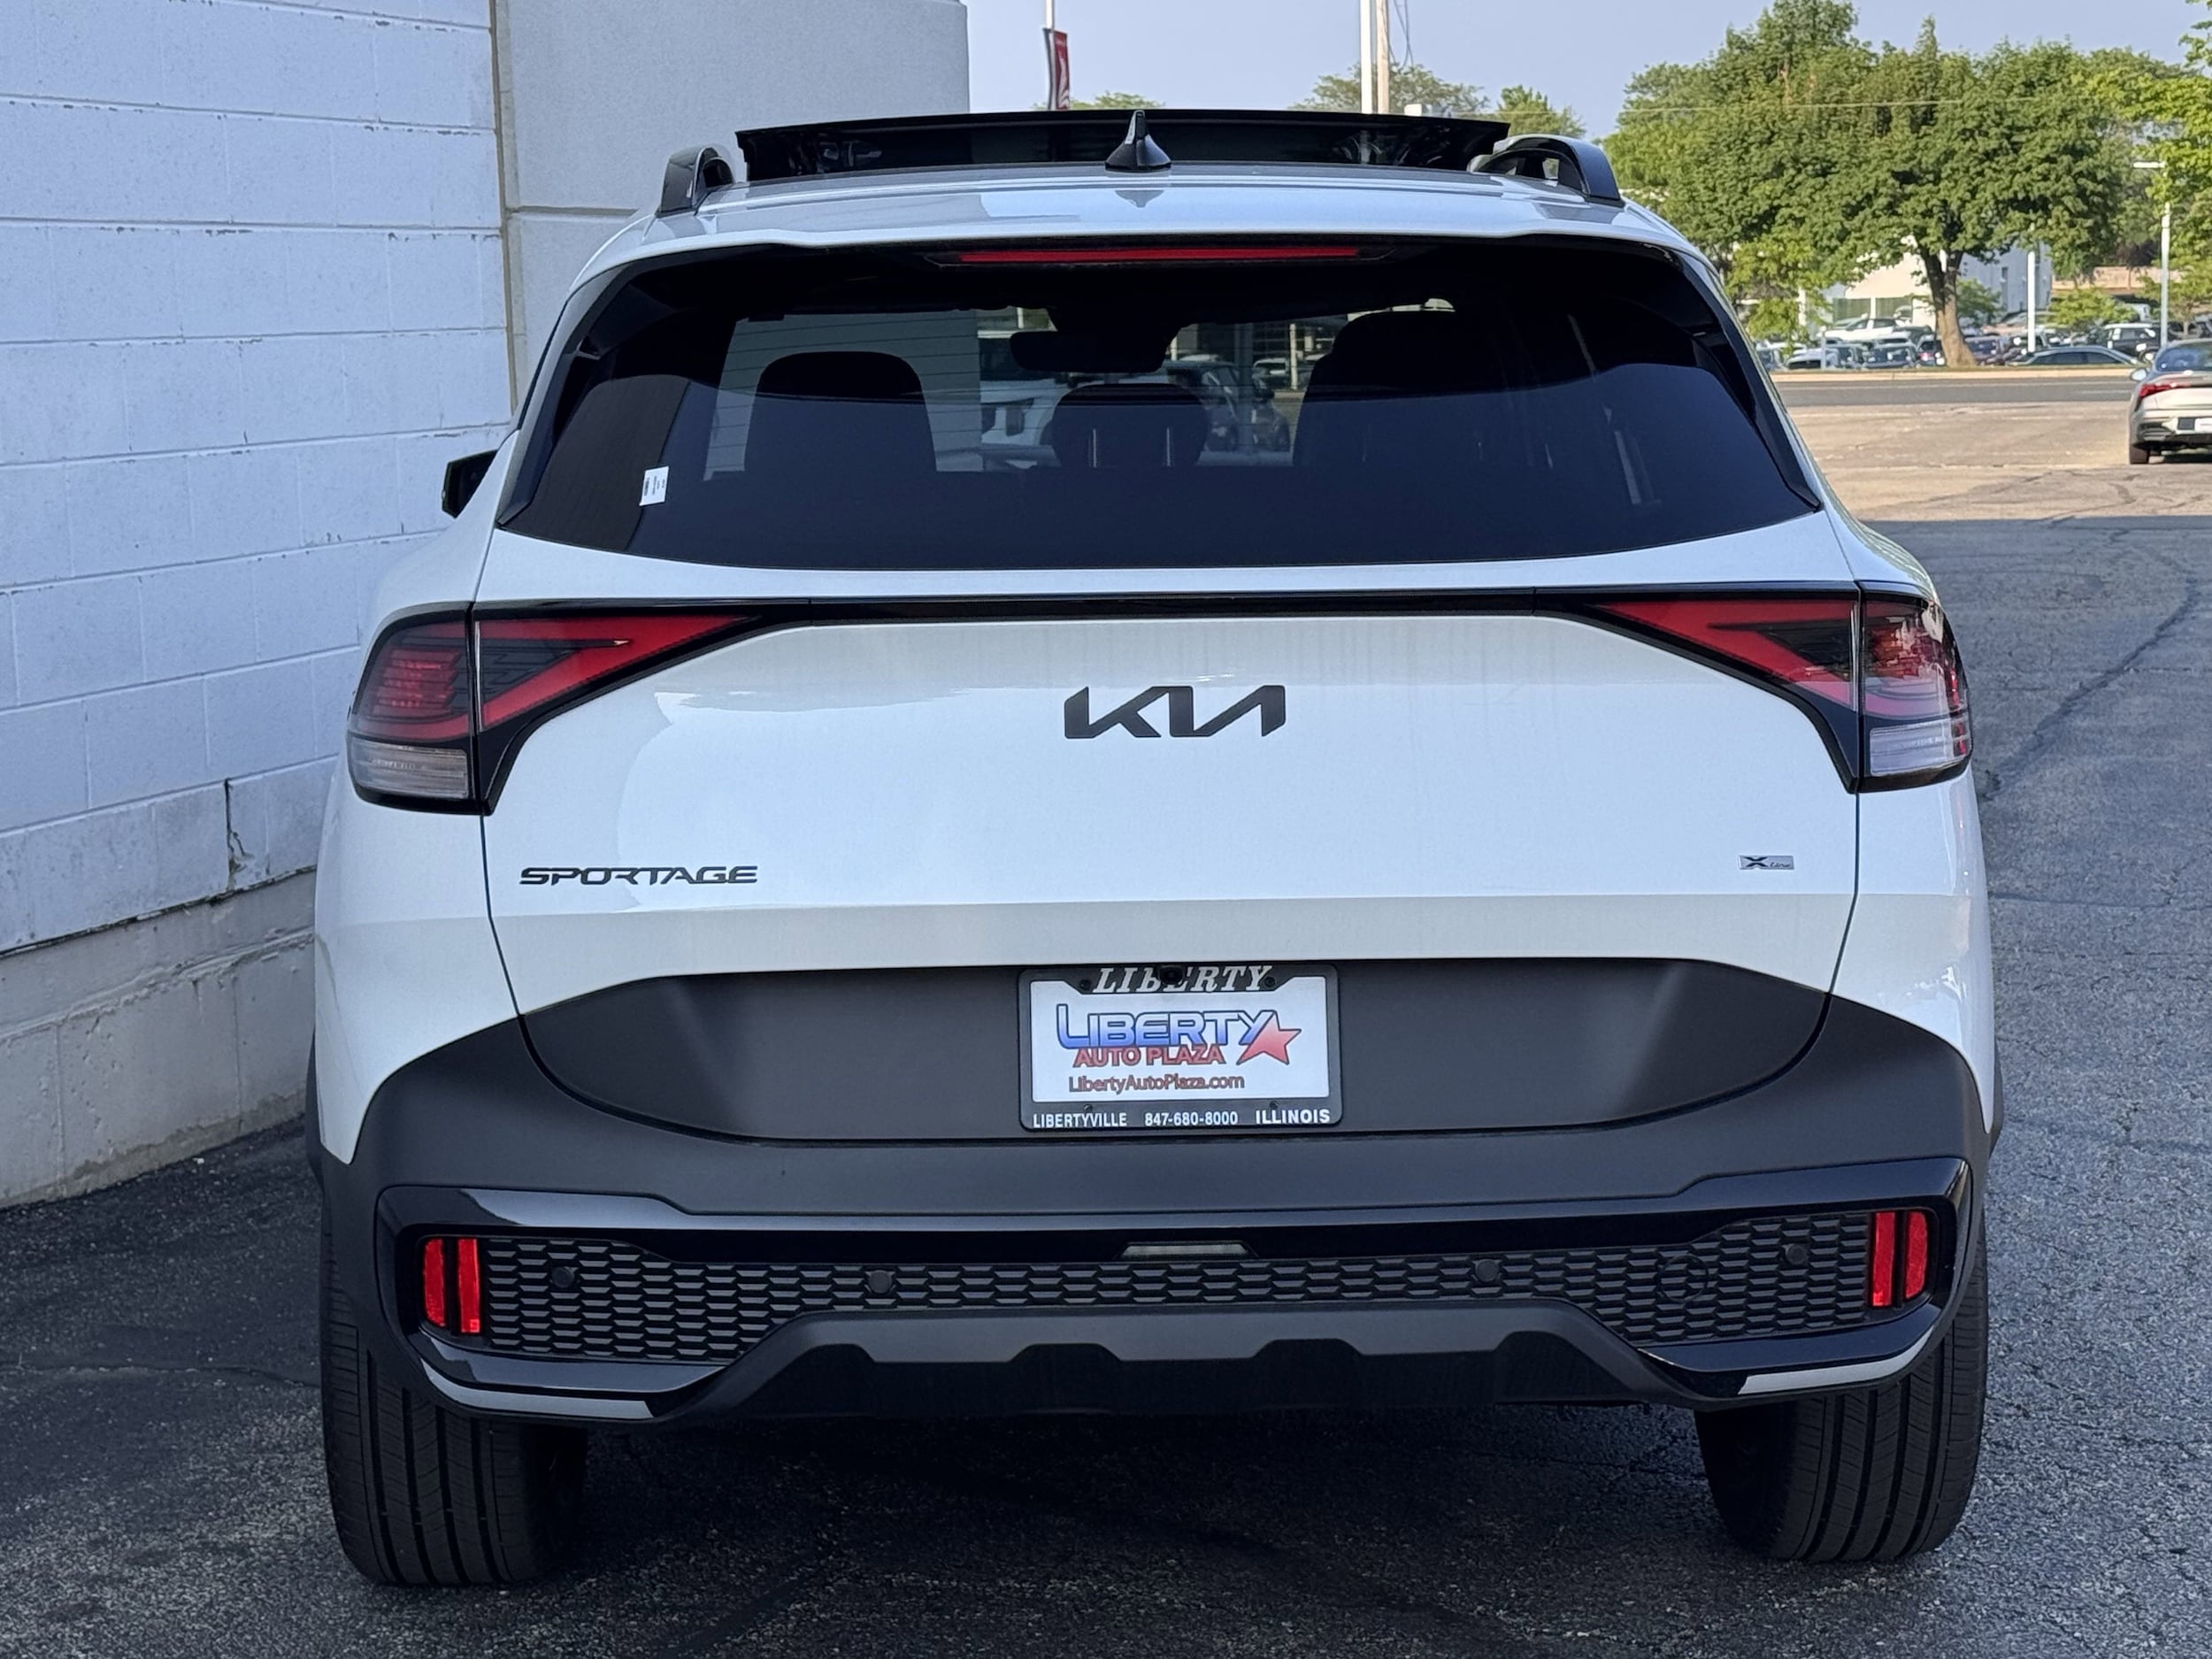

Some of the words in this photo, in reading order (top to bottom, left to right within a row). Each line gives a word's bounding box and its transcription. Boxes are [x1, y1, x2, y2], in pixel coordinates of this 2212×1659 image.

[519, 865, 757, 886] SPORTAGE
[1072, 1046, 1141, 1067] AUTO
[1146, 1043, 1226, 1065] PLAZA
[1068, 1073, 1245, 1095] LibertyAutoPlaza.com
[1033, 1112, 1128, 1128] LIBERTYVILLE
[1144, 1110, 1239, 1127] 847-680-8000
[1256, 1109, 1332, 1125] ILLINOIS
